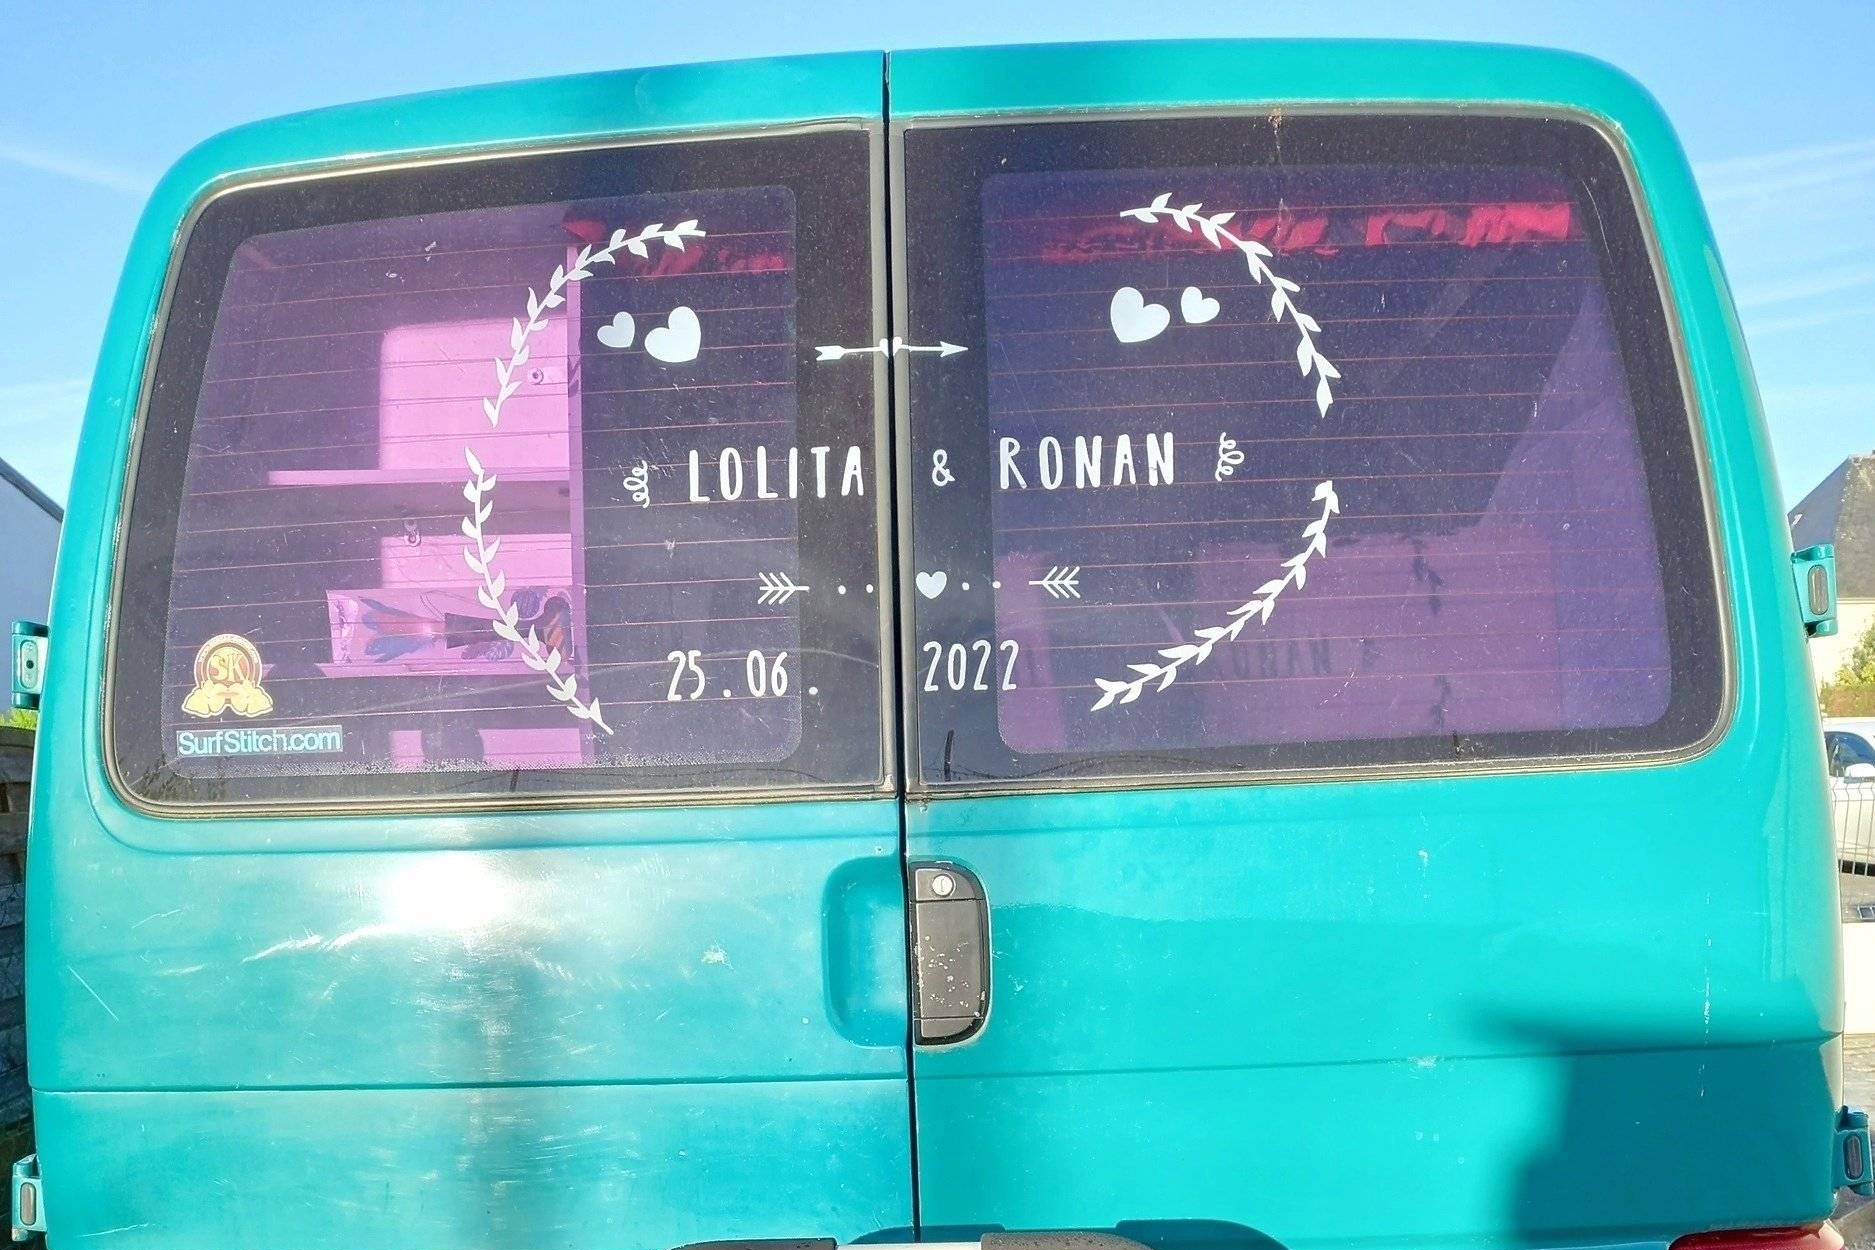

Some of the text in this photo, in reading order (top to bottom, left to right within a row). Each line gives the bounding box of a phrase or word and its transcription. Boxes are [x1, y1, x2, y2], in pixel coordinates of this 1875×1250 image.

[688, 432, 1175, 502] LOLITA & RONAN
[923, 640, 1021, 692] 2022
[178, 730, 341, 755] SurfStitch.com
